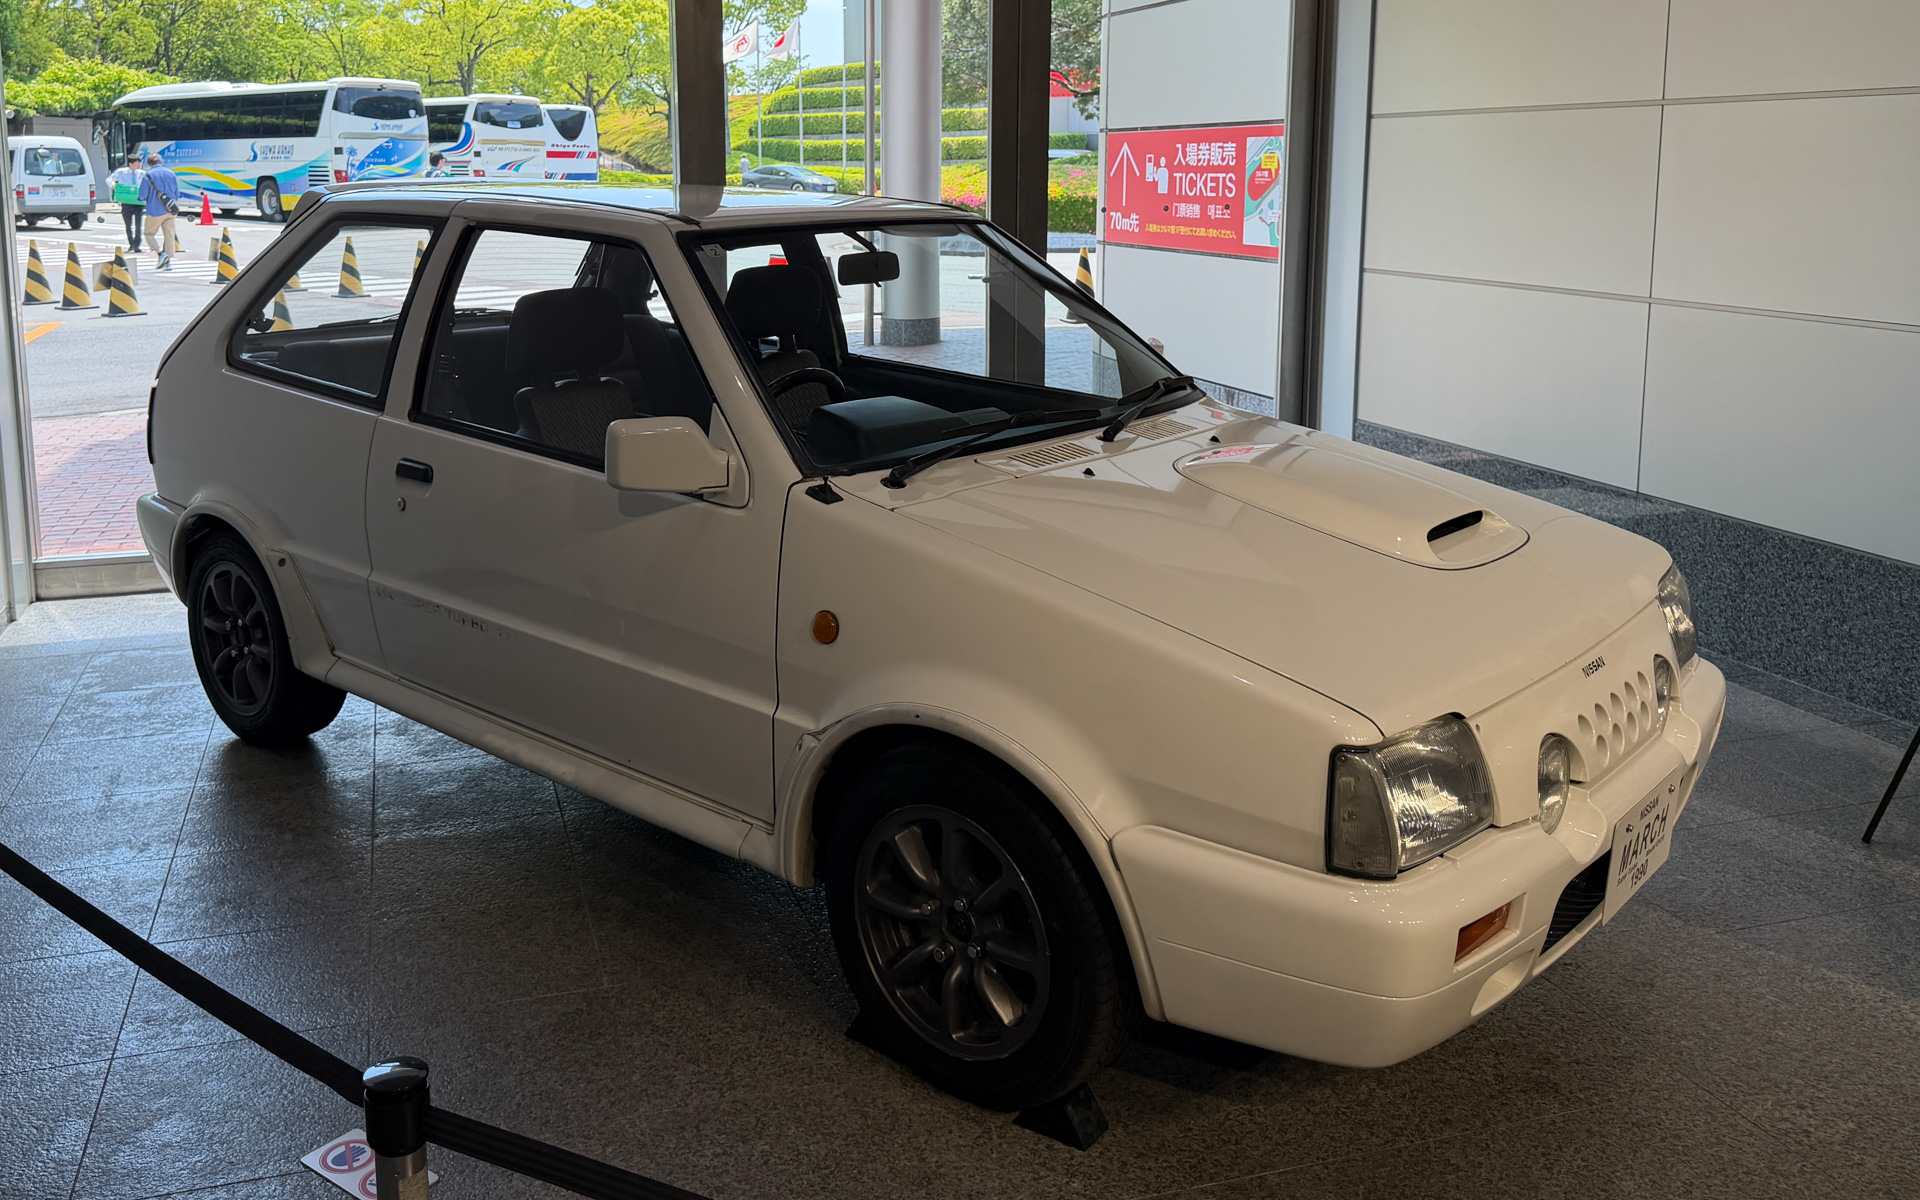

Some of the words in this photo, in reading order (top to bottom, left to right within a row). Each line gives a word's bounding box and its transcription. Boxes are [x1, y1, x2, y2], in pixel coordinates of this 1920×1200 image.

[1173, 142, 1237, 166] 入場券販売
[1173, 172, 1237, 198] TICKETS
[1109, 211, 1140, 233] 70m先
[1582, 655, 1606, 679] NISSAN
[1639, 794, 1660, 822] NISSAN
[1618, 803, 1670, 876] MARCH
[1630, 858, 1649, 890] 1990
